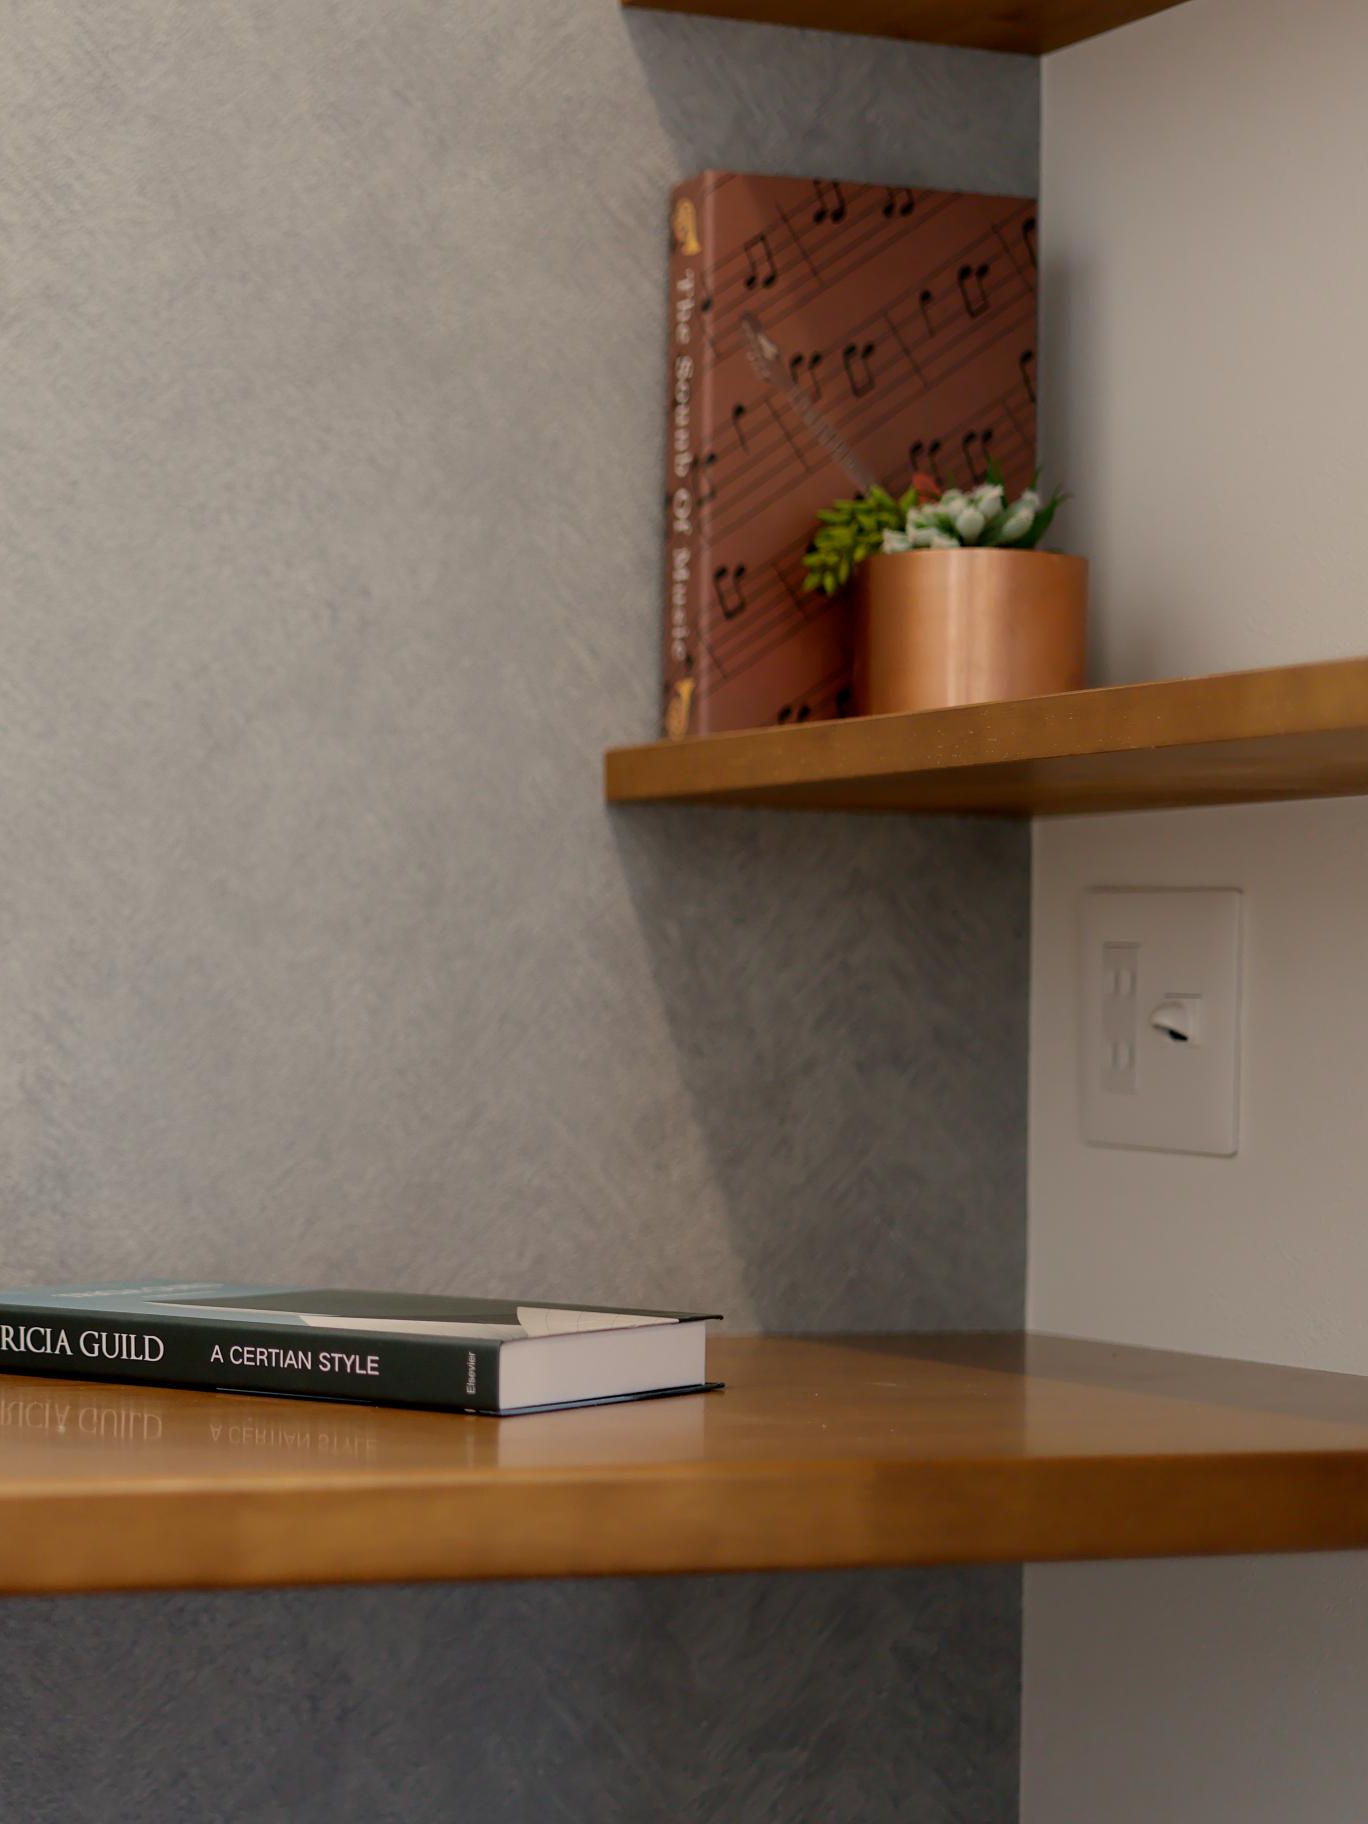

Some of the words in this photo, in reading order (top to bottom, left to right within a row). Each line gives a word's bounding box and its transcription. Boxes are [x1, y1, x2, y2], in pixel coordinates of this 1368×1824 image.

[675, 267, 695, 344] The
[673, 488, 693, 536] Of
[671, 547, 691, 661] Music
[79, 1330, 165, 1362] GUILD
[210, 1344, 225, 1363] A
[229, 1346, 312, 1370] CERTIAN
[318, 1352, 380, 1376] STYLE
